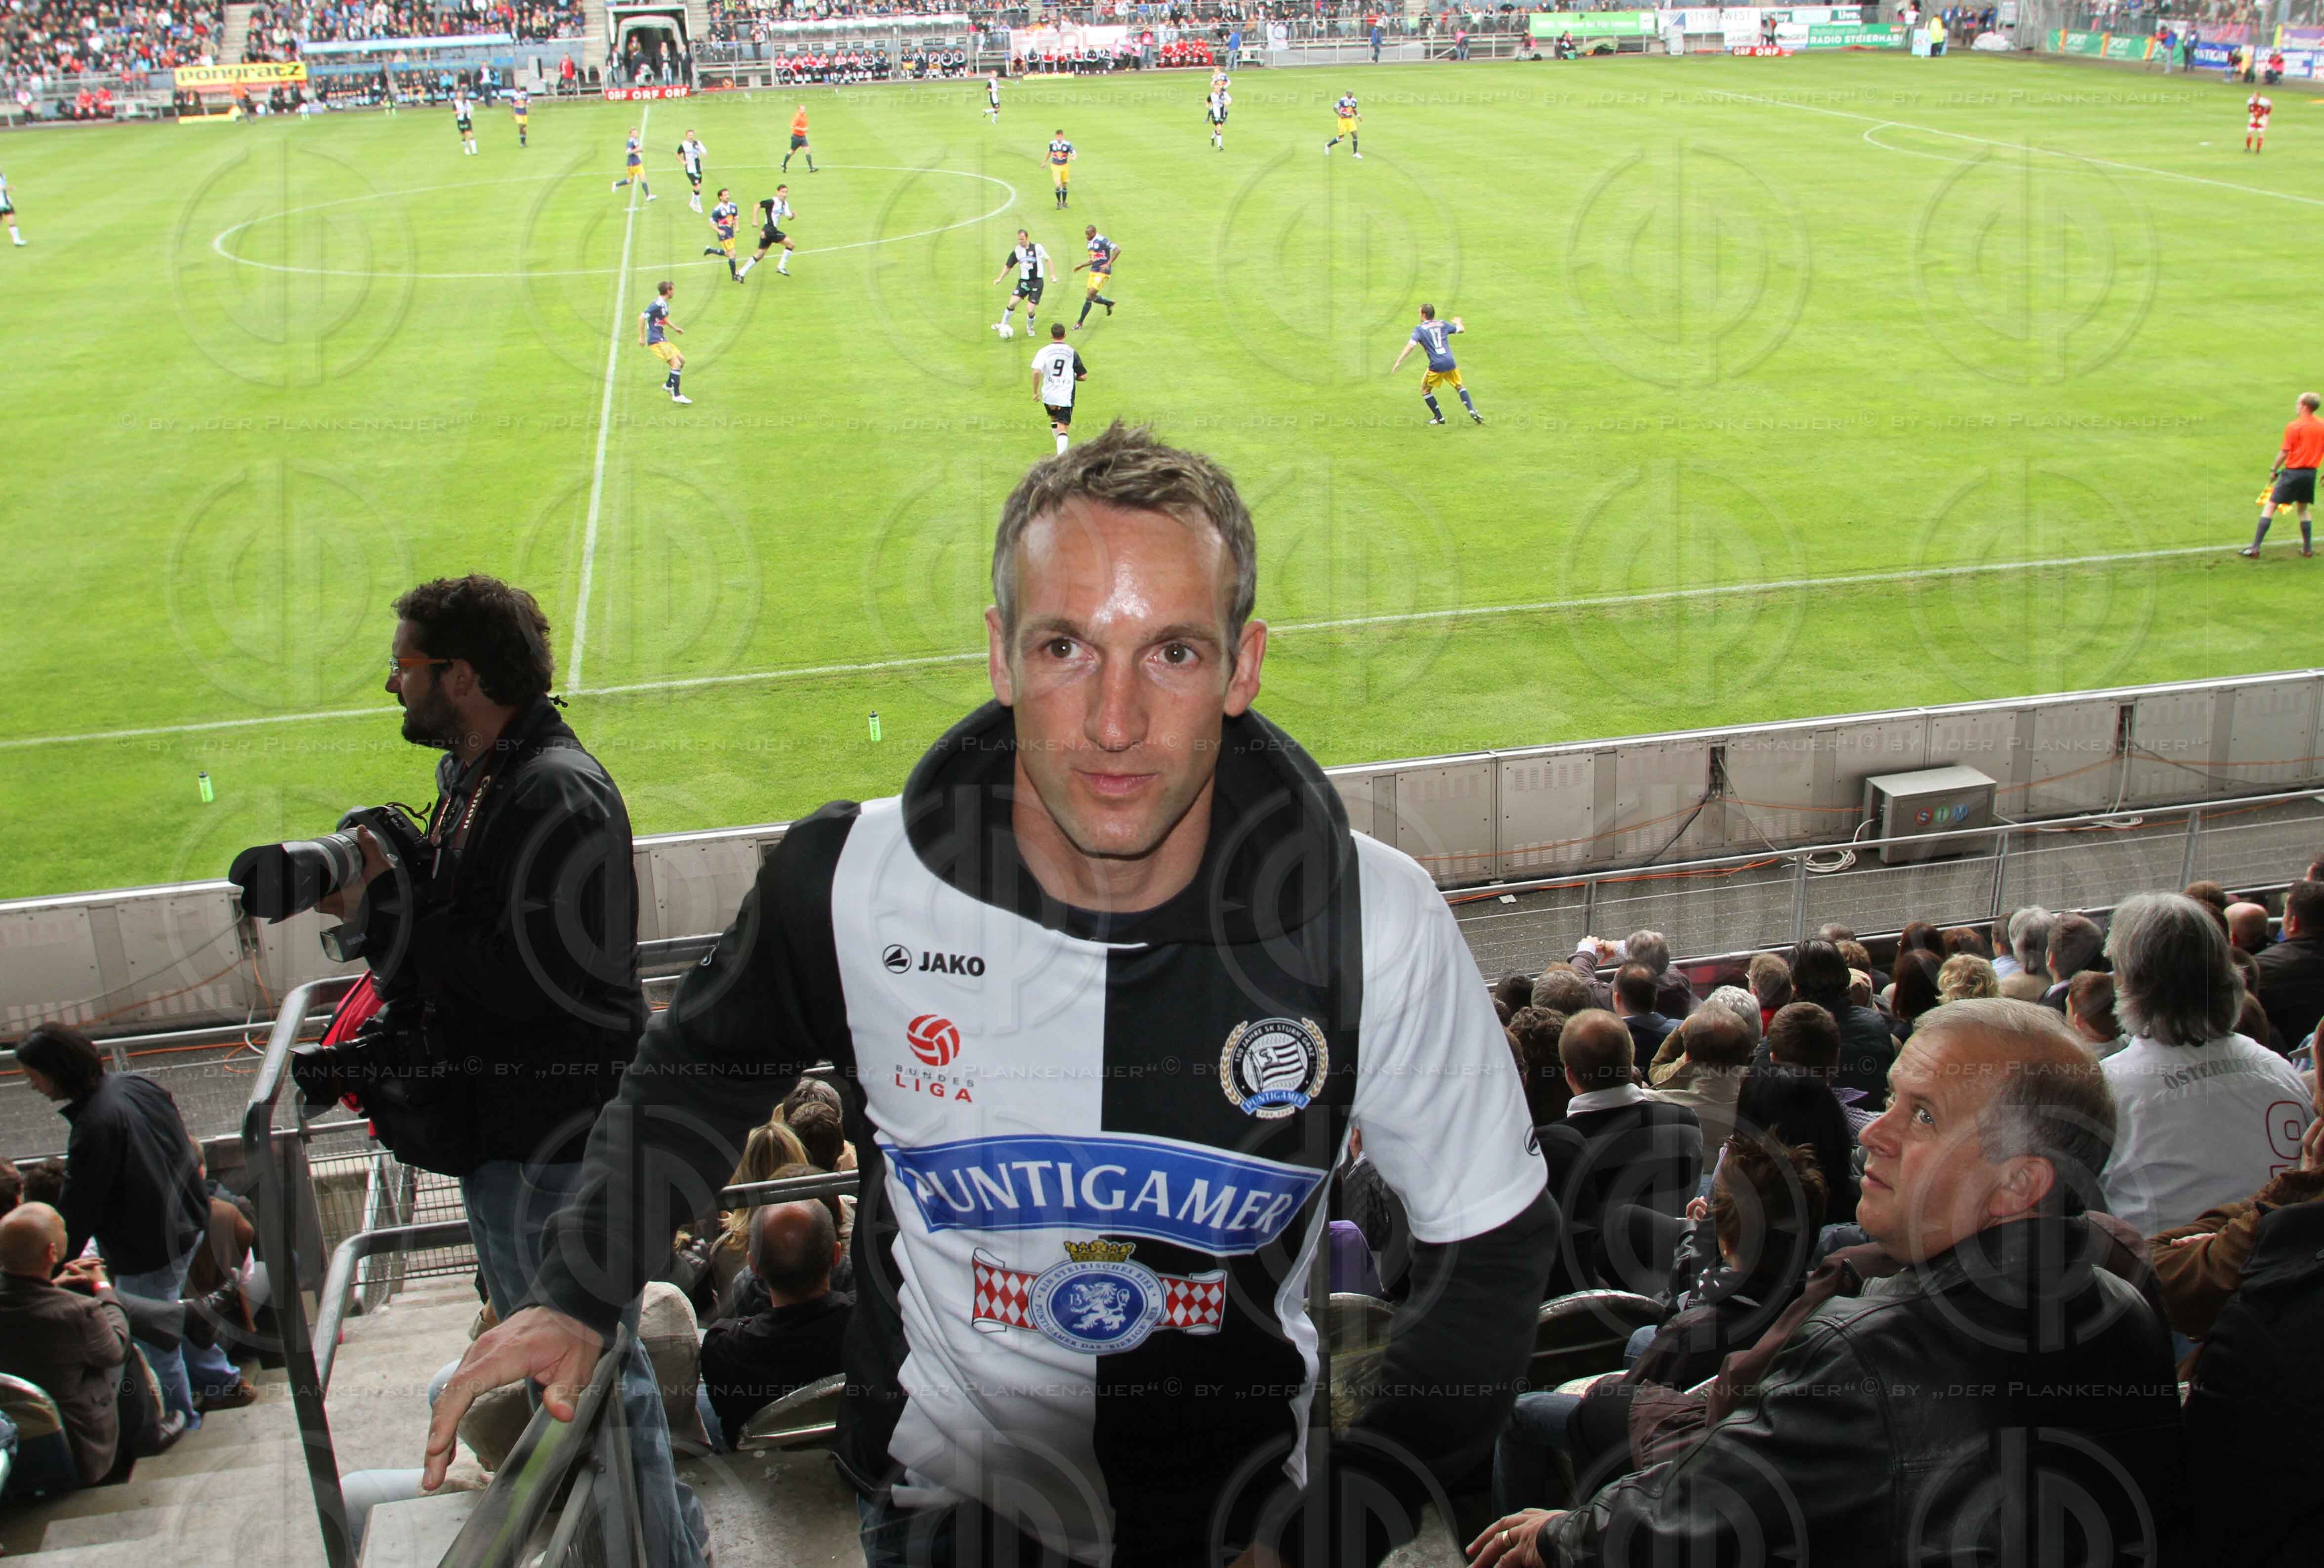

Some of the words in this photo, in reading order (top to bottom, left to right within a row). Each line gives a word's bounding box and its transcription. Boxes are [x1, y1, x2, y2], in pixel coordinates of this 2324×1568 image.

[1810, 36, 1842, 44] RADIO
[1755, 47, 1780, 56] ORF
[632, 90, 660, 100] ORF
[664, 87, 687, 98] ORF
[1429, 327, 1442, 348] 17
[1052, 359, 1065, 376] 9
[463, 775, 491, 829] Canon
[918, 951, 985, 977] JAKO
[1242, 1028, 1263, 1048] JAHRE
[1277, 1024, 1302, 1038] STURM
[896, 1064, 974, 1087] BUNDES
[896, 1073, 973, 1103] LIGA
[1245, 1091, 1305, 1110] PUNTIGAMER
